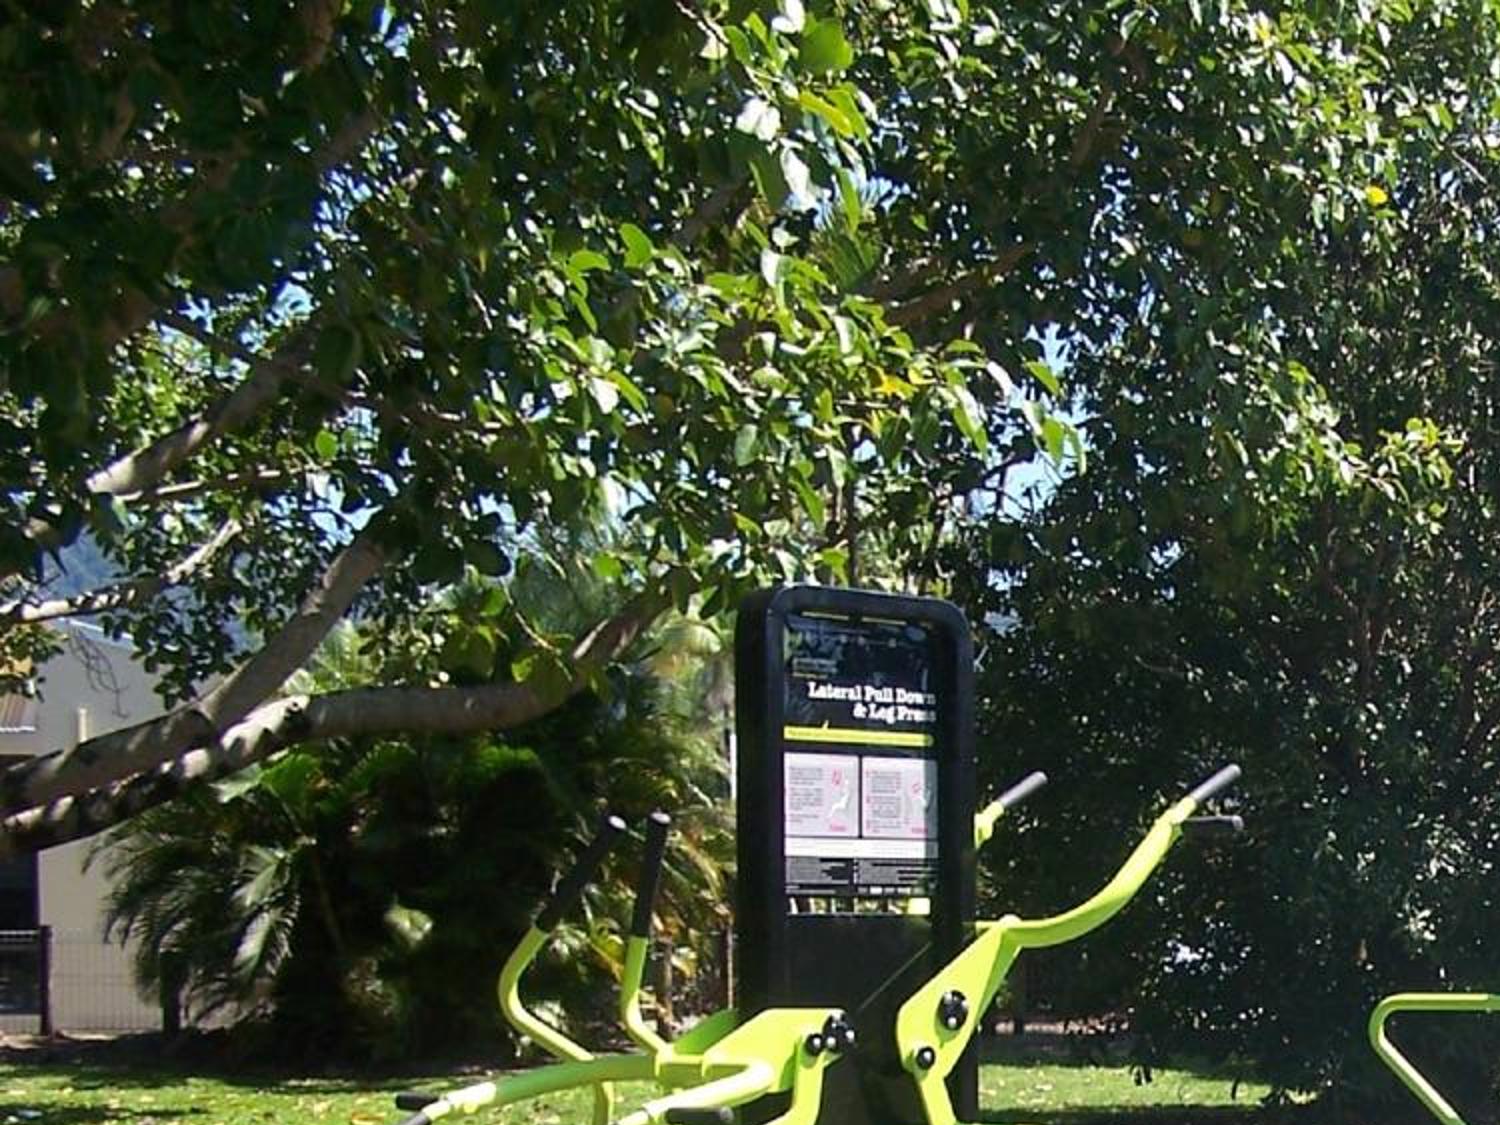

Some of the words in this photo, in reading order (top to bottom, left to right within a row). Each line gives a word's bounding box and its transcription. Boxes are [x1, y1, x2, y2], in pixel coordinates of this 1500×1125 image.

[808, 681, 862, 701] Lateral
[864, 685, 893, 703] Pull
[896, 688, 936, 705] Down
[853, 702, 867, 719] &
[868, 703, 896, 725] Leg
